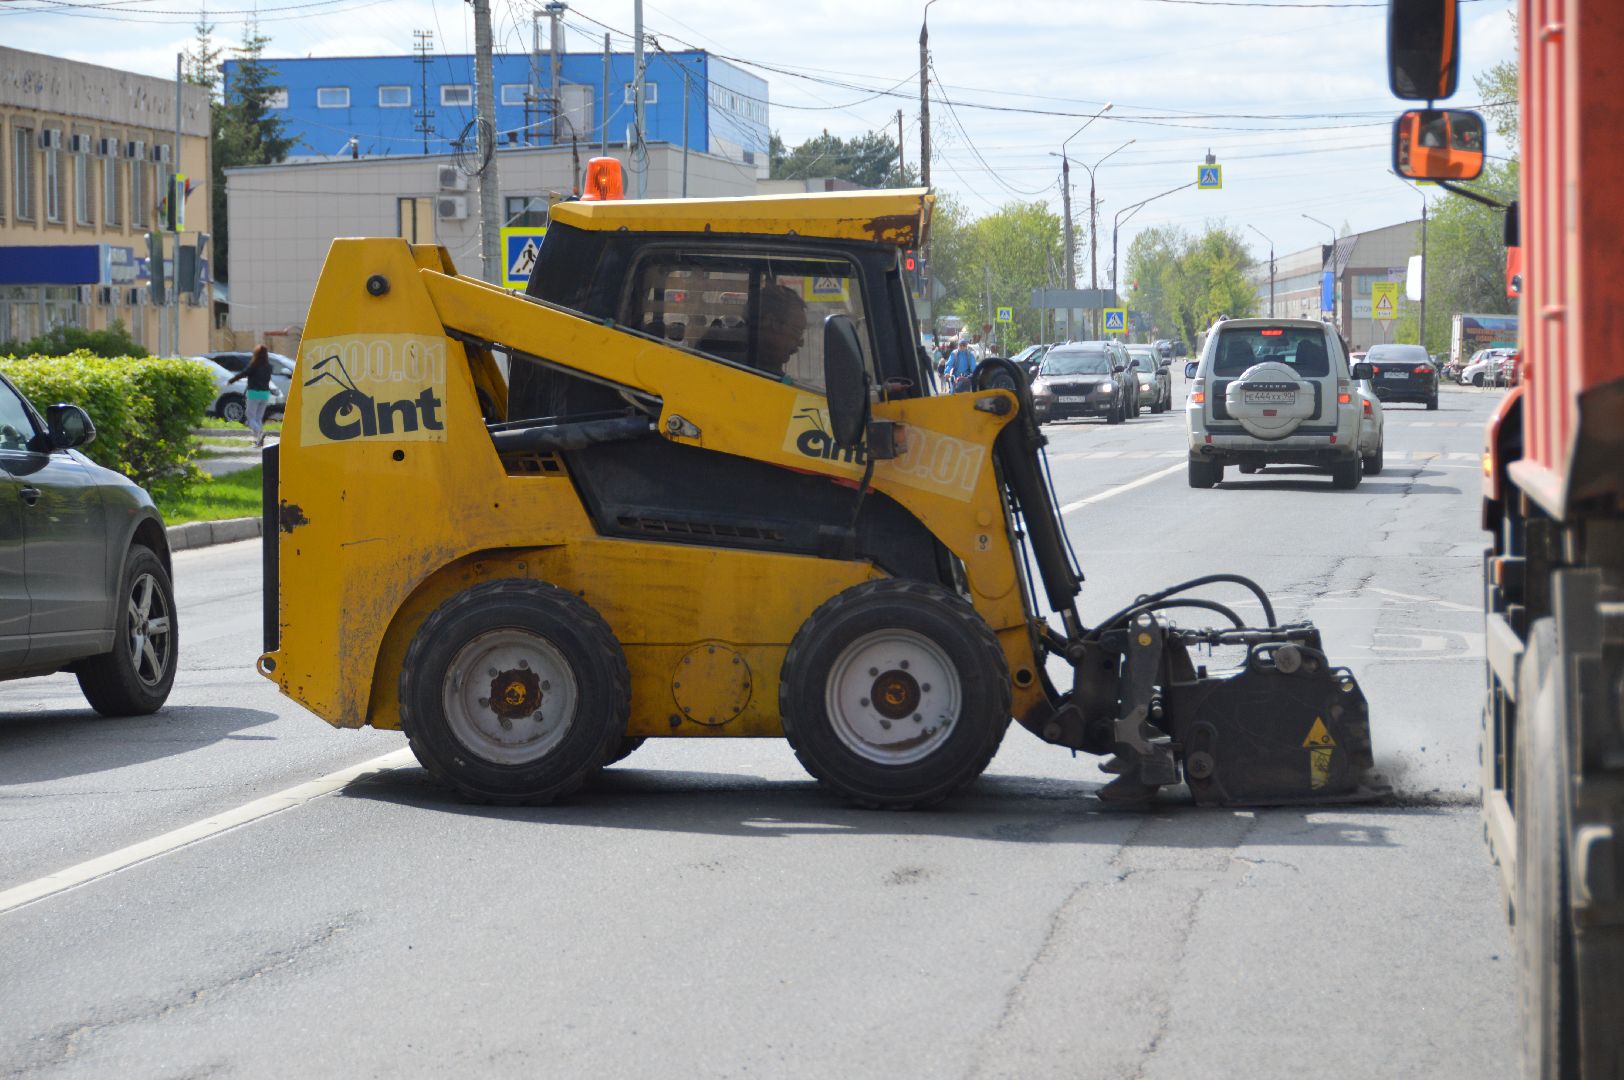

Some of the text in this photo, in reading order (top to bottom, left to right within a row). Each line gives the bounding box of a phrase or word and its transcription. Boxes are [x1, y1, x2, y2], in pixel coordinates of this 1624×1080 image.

[305, 339, 445, 386] 1000.01
[319, 387, 444, 441] ant
[891, 424, 986, 491] 0.01
